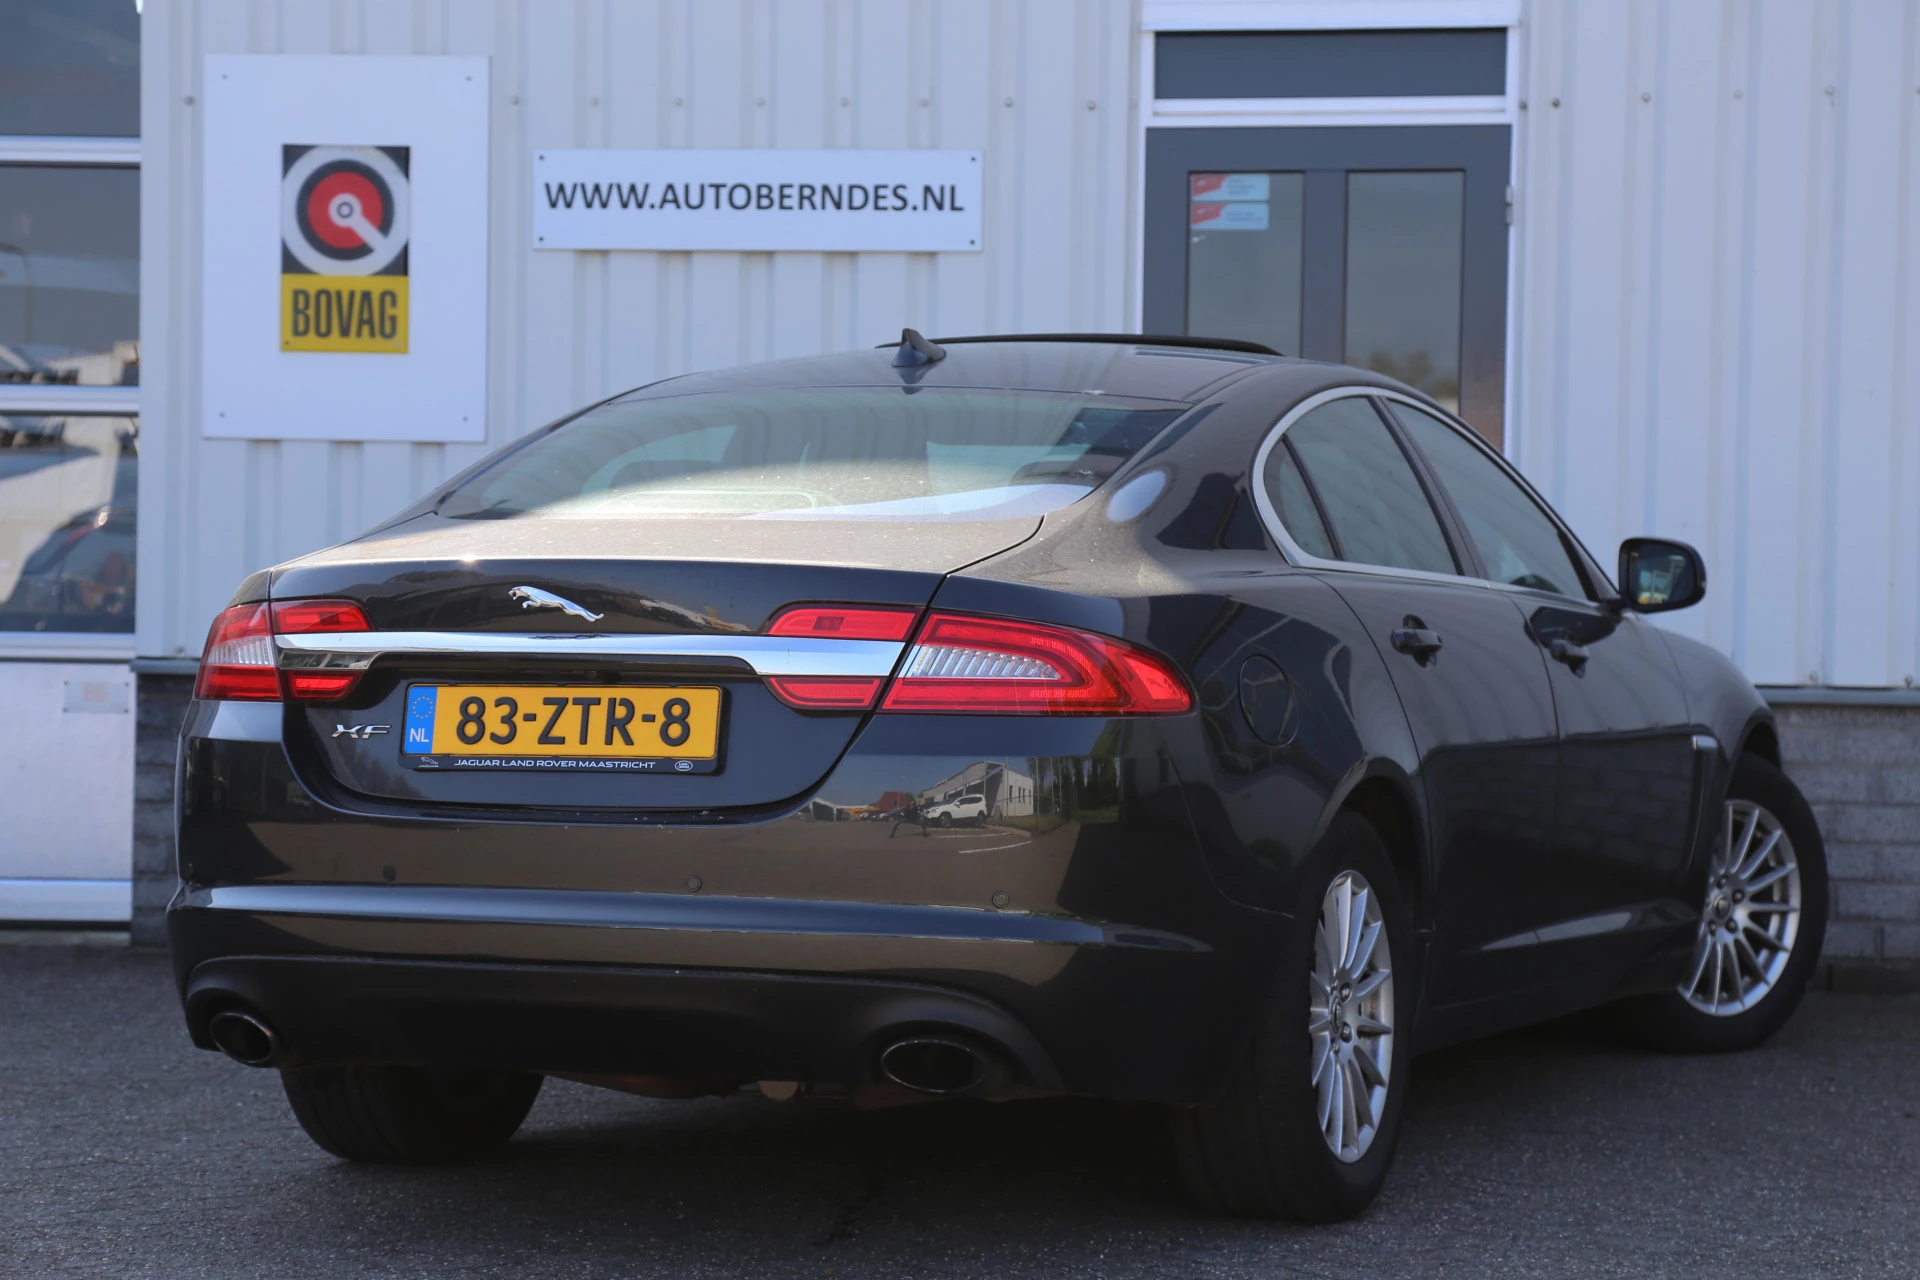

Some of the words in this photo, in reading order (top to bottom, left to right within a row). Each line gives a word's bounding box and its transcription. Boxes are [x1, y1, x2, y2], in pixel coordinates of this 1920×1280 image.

[544, 181, 965, 212] WWW.AUTOBERNDES.NL
[291, 288, 398, 340] BOVAG
[331, 724, 392, 739] XF
[456, 696, 691, 747] 83-ZTR-8
[409, 727, 430, 742] NL
[454, 759, 500, 767] JAGUAR
[536, 760, 577, 768] ROVER
[578, 761, 656, 769] MAASTRICHT
